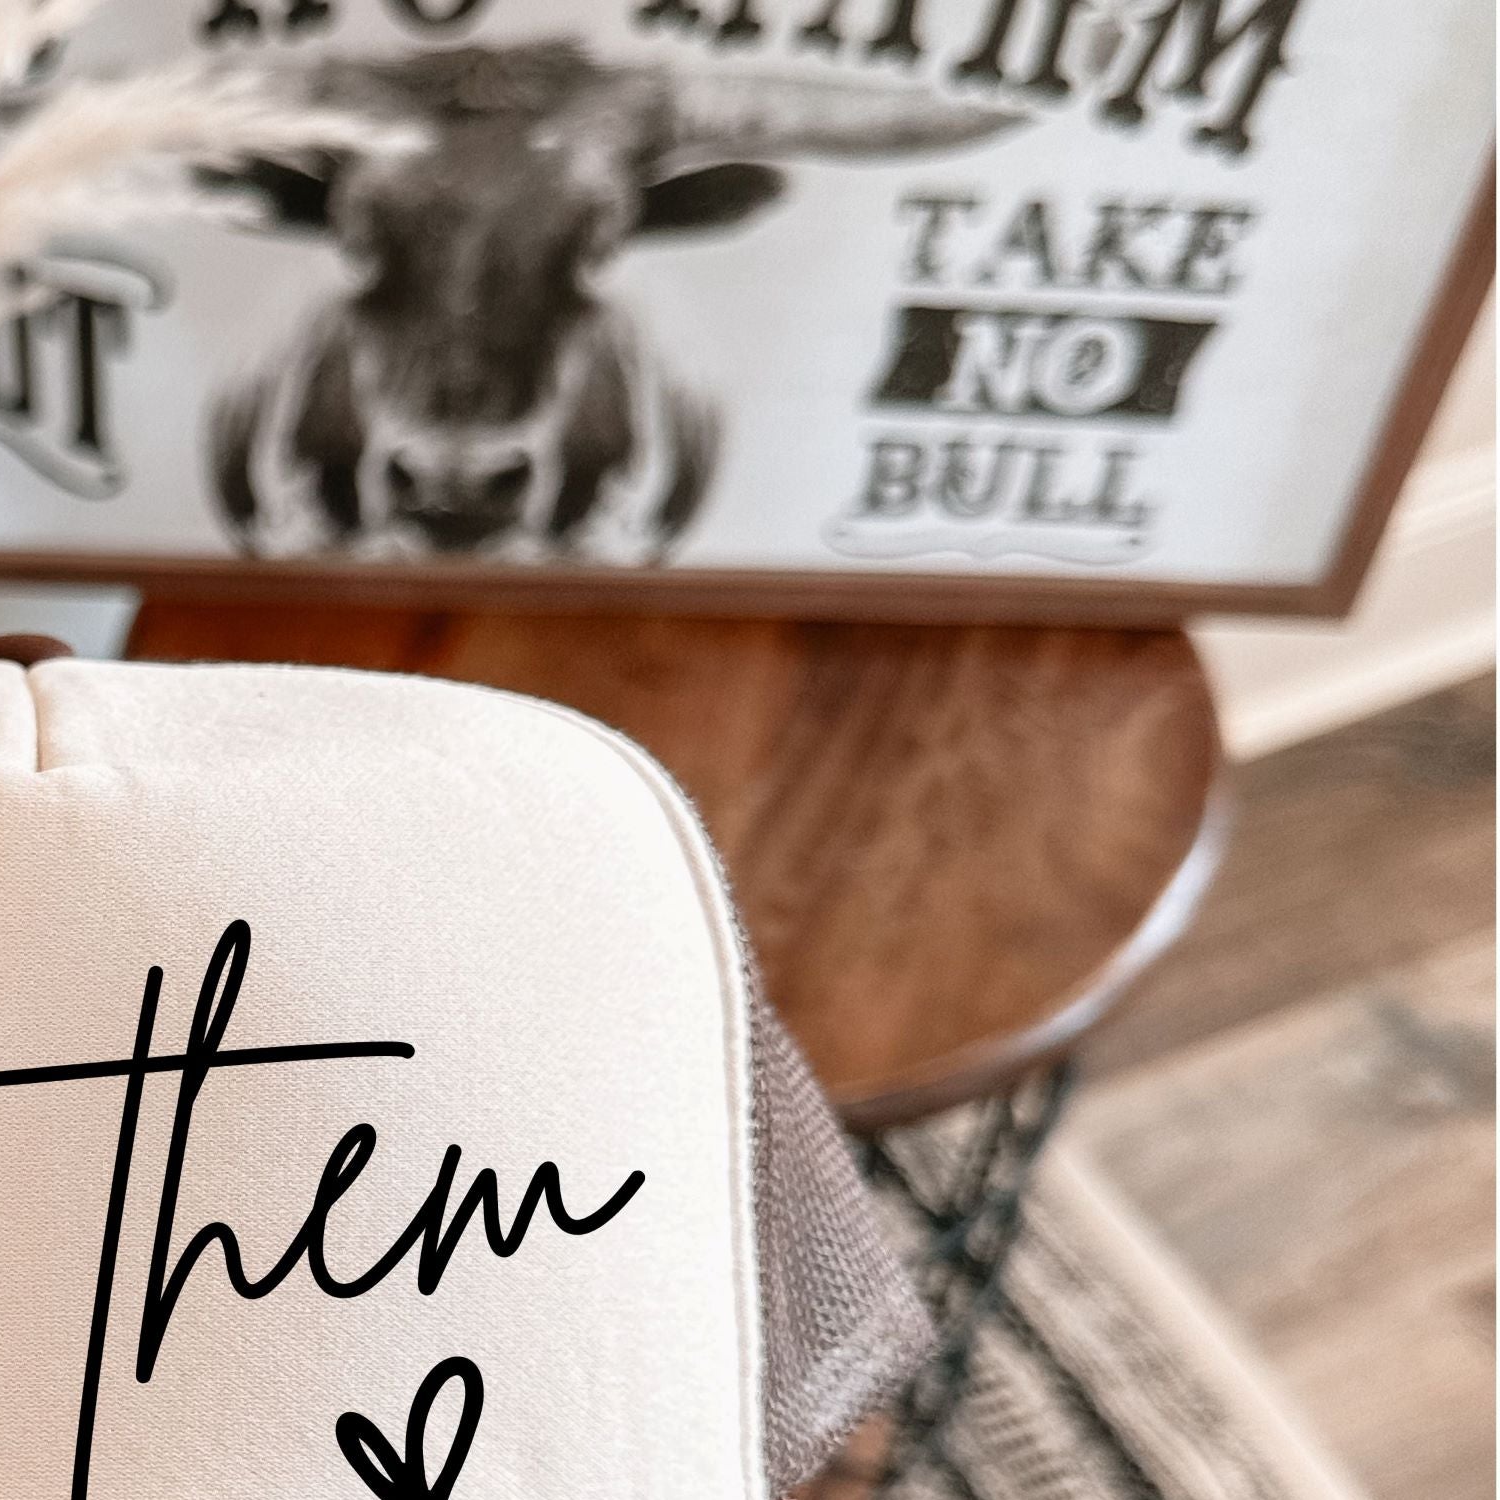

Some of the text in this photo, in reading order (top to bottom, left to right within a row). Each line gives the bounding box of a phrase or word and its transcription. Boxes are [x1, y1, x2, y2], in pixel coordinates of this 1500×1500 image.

[896, 192, 1255, 296] TAKE
[936, 314, 1140, 416] NO
[862, 440, 1152, 527] BULL
